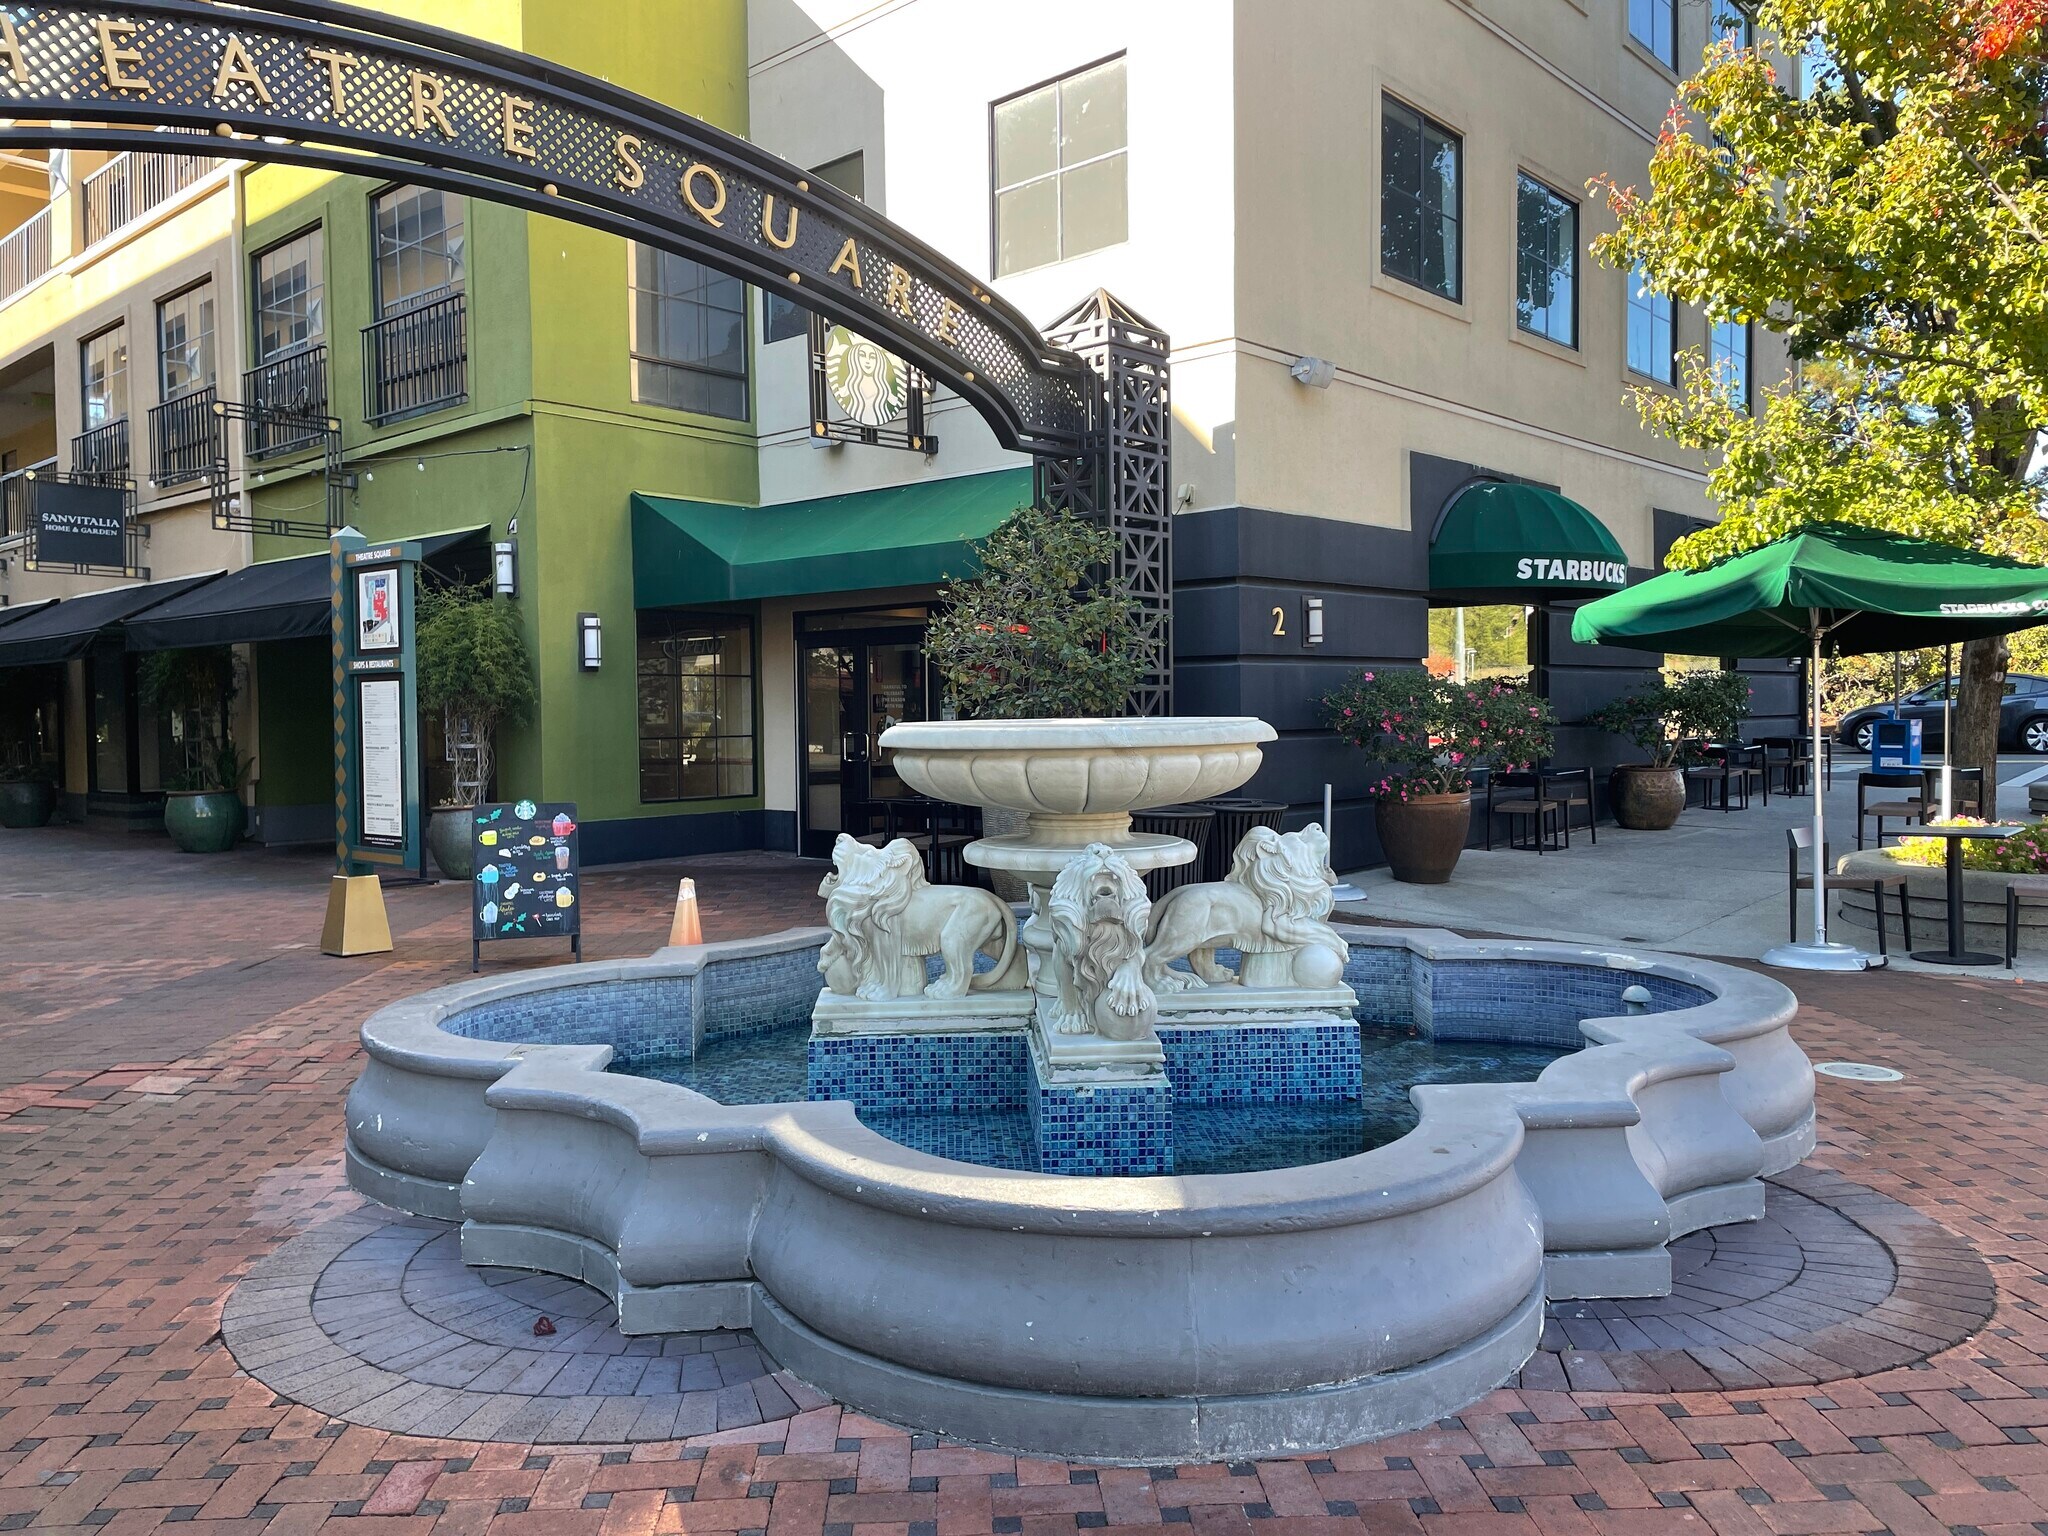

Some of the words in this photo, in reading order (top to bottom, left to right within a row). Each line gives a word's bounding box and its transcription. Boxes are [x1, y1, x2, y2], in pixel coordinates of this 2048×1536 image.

[614, 134, 962, 346] SQUARE
[42, 512, 120, 528] SANVITALIA
[45, 524, 71, 533] HOME
[80, 527, 118, 536] GARDEN
[355, 551, 373, 561] THEATRE
[373, 548, 391, 559] SQUARE
[1516, 558, 1625, 584] STARBUCKS
[1271, 606, 1286, 636] 2
